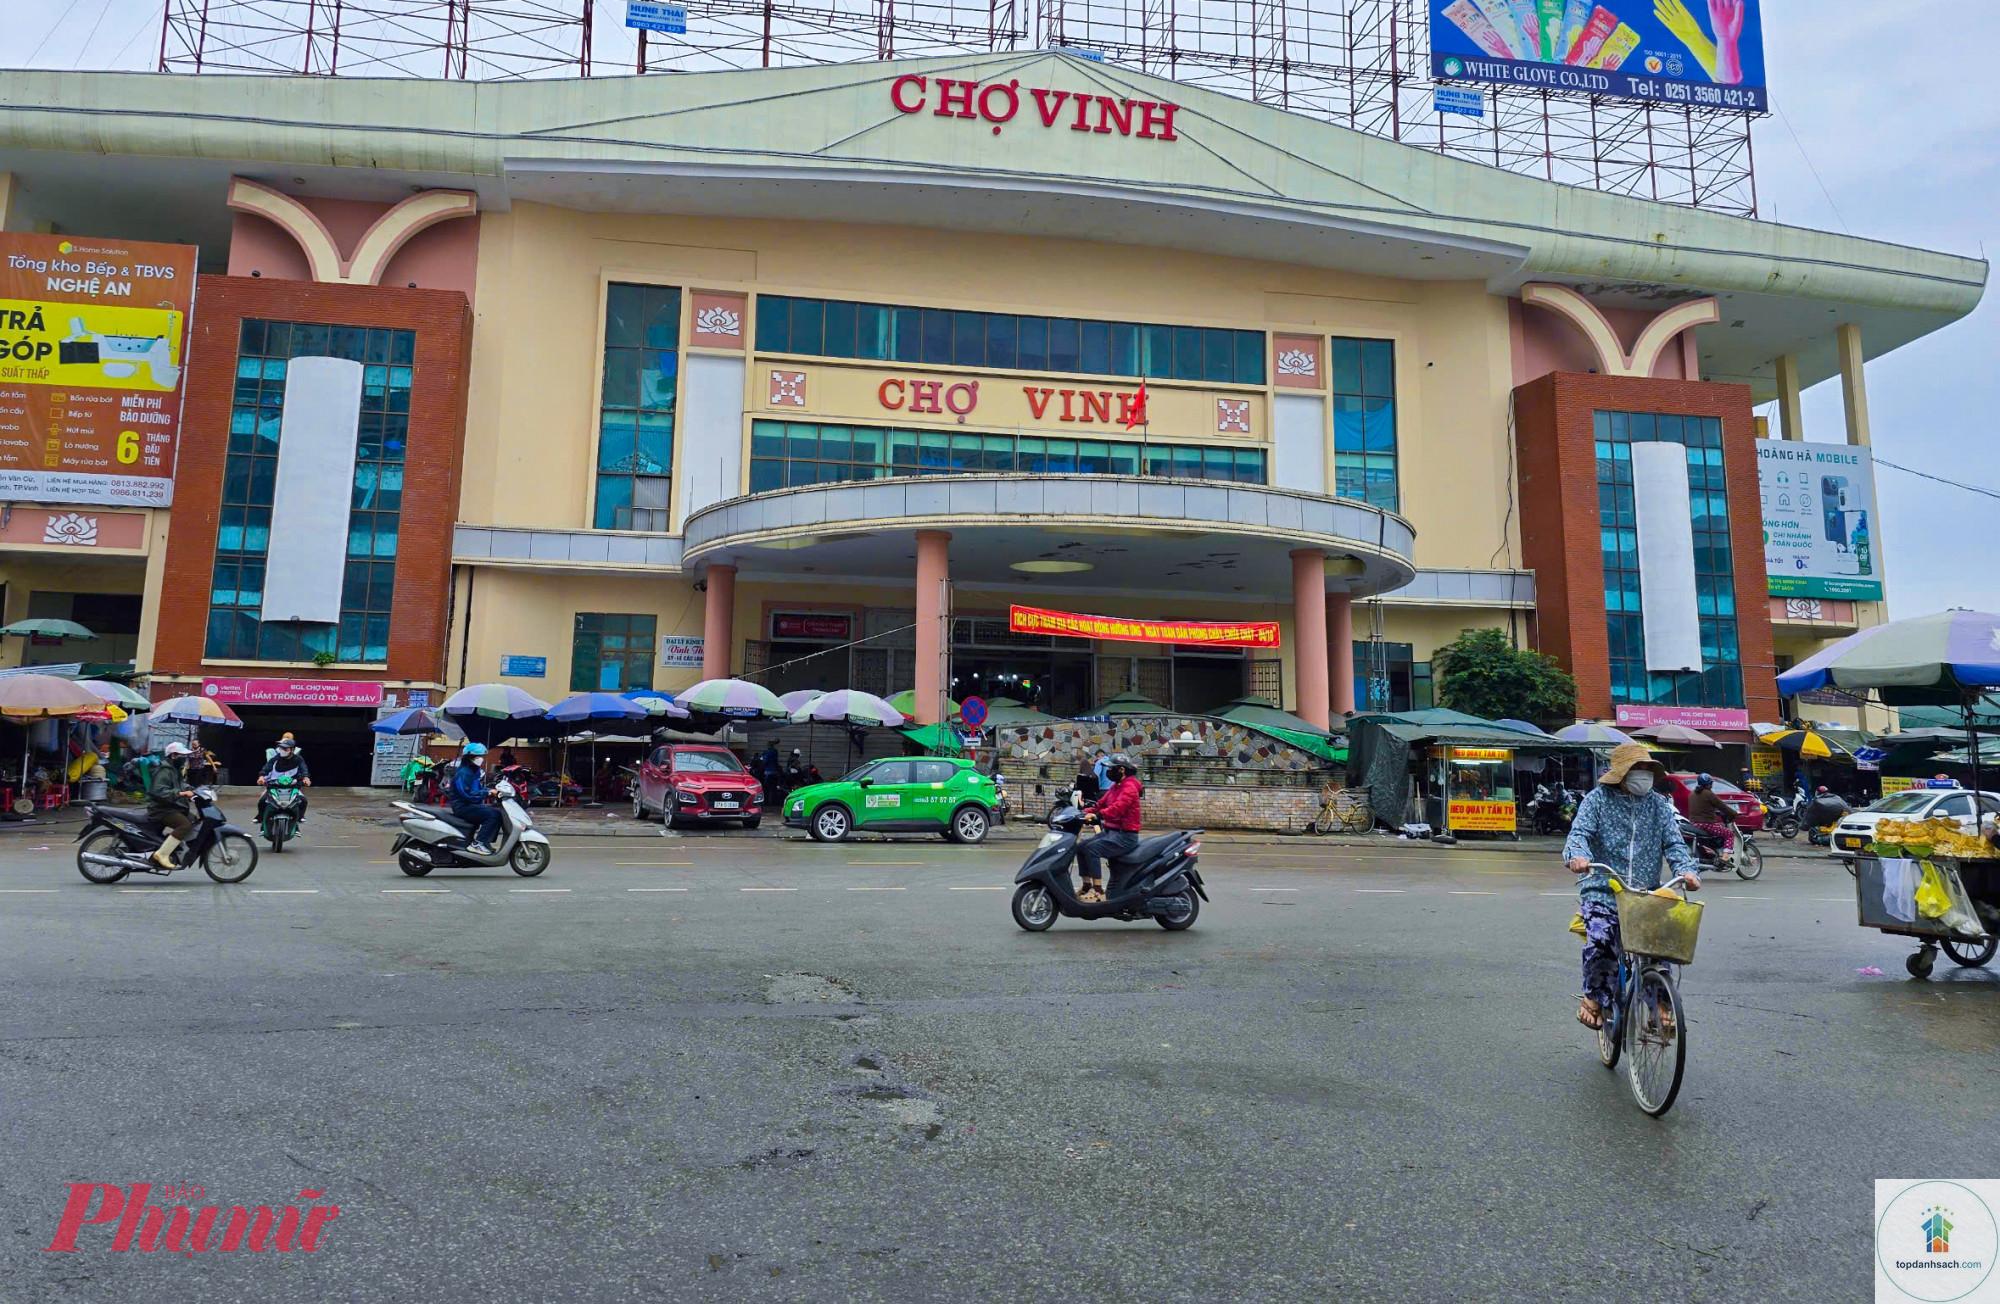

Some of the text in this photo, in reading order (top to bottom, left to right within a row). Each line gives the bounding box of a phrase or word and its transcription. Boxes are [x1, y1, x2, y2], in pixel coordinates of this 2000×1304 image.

[1465, 61, 1609, 91] WHITE GLOVE CO.,LTD
[1627, 77, 1756, 107] Tel: 0251 3560 421-2
[891, 74, 1180, 141] CHỢ VINH
[8, 254, 175, 280] Tổng kho Bếp & TBVS
[47, 277, 131, 298] NGHỆ AN
[0, 306, 46, 332] TRẢ
[0, 336, 53, 361] GÓP
[122, 394, 162, 410] MIỄN PHÍ
[878, 379, 1149, 425] CHỢ VINH
[120, 409, 171, 425] BẢO DƯỠNG
[116, 430, 140, 464] 6
[146, 432, 171, 444] THÁNG
[144, 455, 160, 466] TIÊN
[1797, 450, 1812, 462] HÀ
[1816, 453, 1858, 465] MOBILE
[1772, 539, 1791, 547] TOÀN
[327, 693, 338, 702] TÔ
[356, 694, 376, 702] MÁY
[1450, 805, 1464, 814] HEO
[1466, 805, 1486, 815] QUAY
